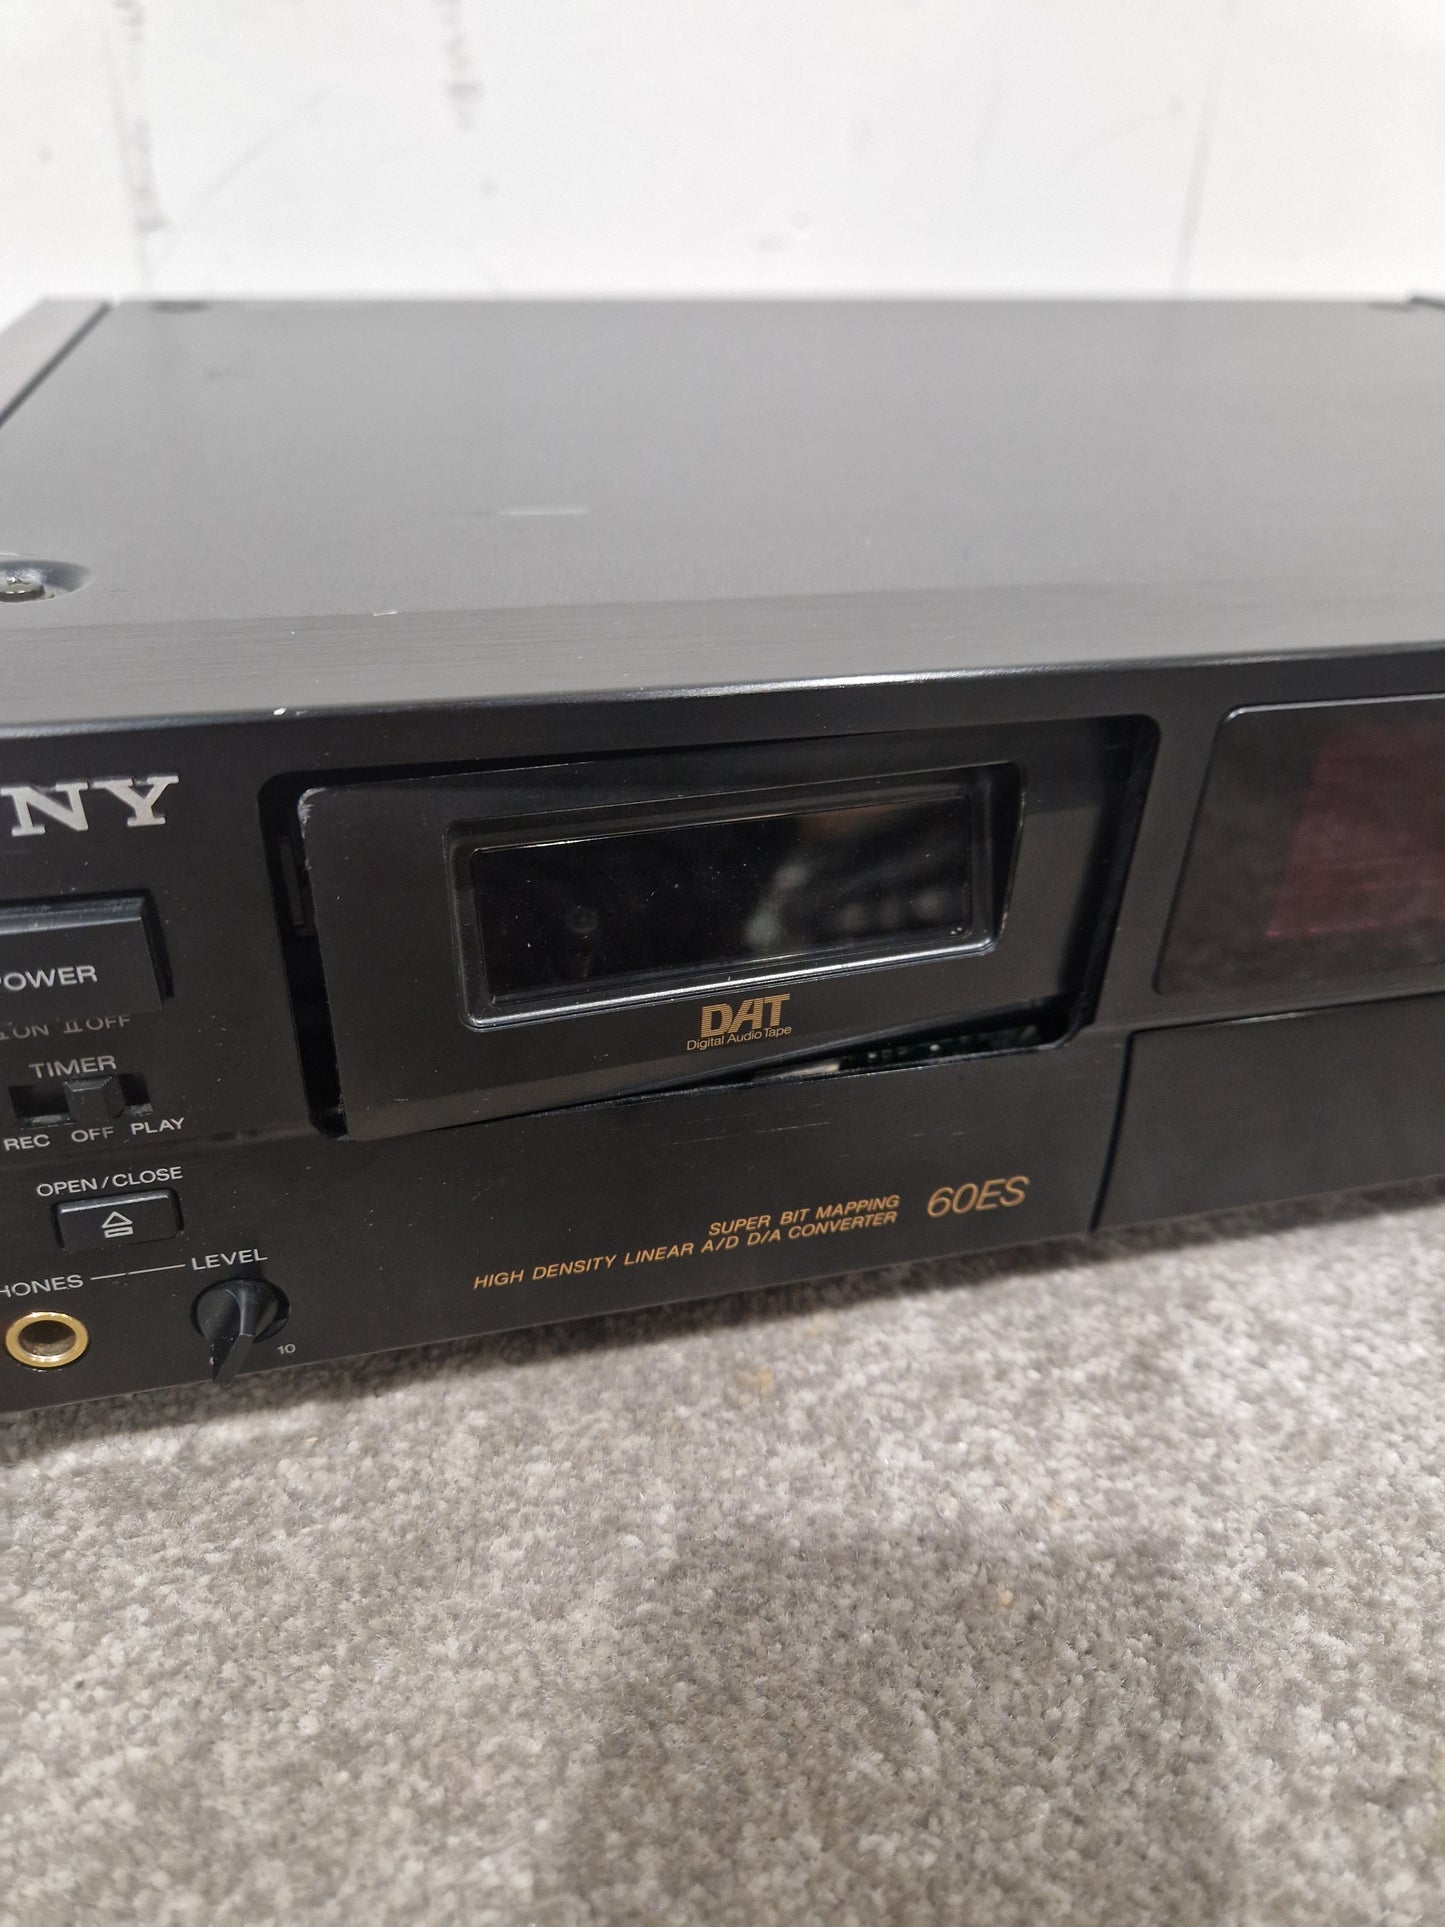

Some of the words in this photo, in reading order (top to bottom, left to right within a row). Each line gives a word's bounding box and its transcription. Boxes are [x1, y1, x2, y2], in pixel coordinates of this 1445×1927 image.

[0, 965, 98, 992] OWER
[701, 993, 791, 1038] DAT
[686, 1037, 725, 1051] Digital
[726, 1030, 762, 1044] Audio
[763, 1026, 793, 1039] Tape
[29, 1055, 117, 1079] TIMER
[3, 1134, 51, 1151] REC
[71, 1126, 114, 1143] OFF
[130, 1117, 185, 1136] PLAY
[926, 1175, 1030, 1219] 60ES
[708, 1215, 771, 1236] SUPER
[779, 1208, 811, 1226] BIT
[815, 1195, 901, 1220] MAPPING
[191, 1248, 268, 1271] LEVEL
[473, 1269, 525, 1291] HIGH
[531, 1254, 617, 1281] DENSITY
[623, 1242, 694, 1267] LINEAR
[700, 1234, 739, 1254] A/D
[746, 1230, 781, 1247] D/A
[787, 1210, 899, 1240] CONVERTER
[277, 1342, 297, 1355] 10
